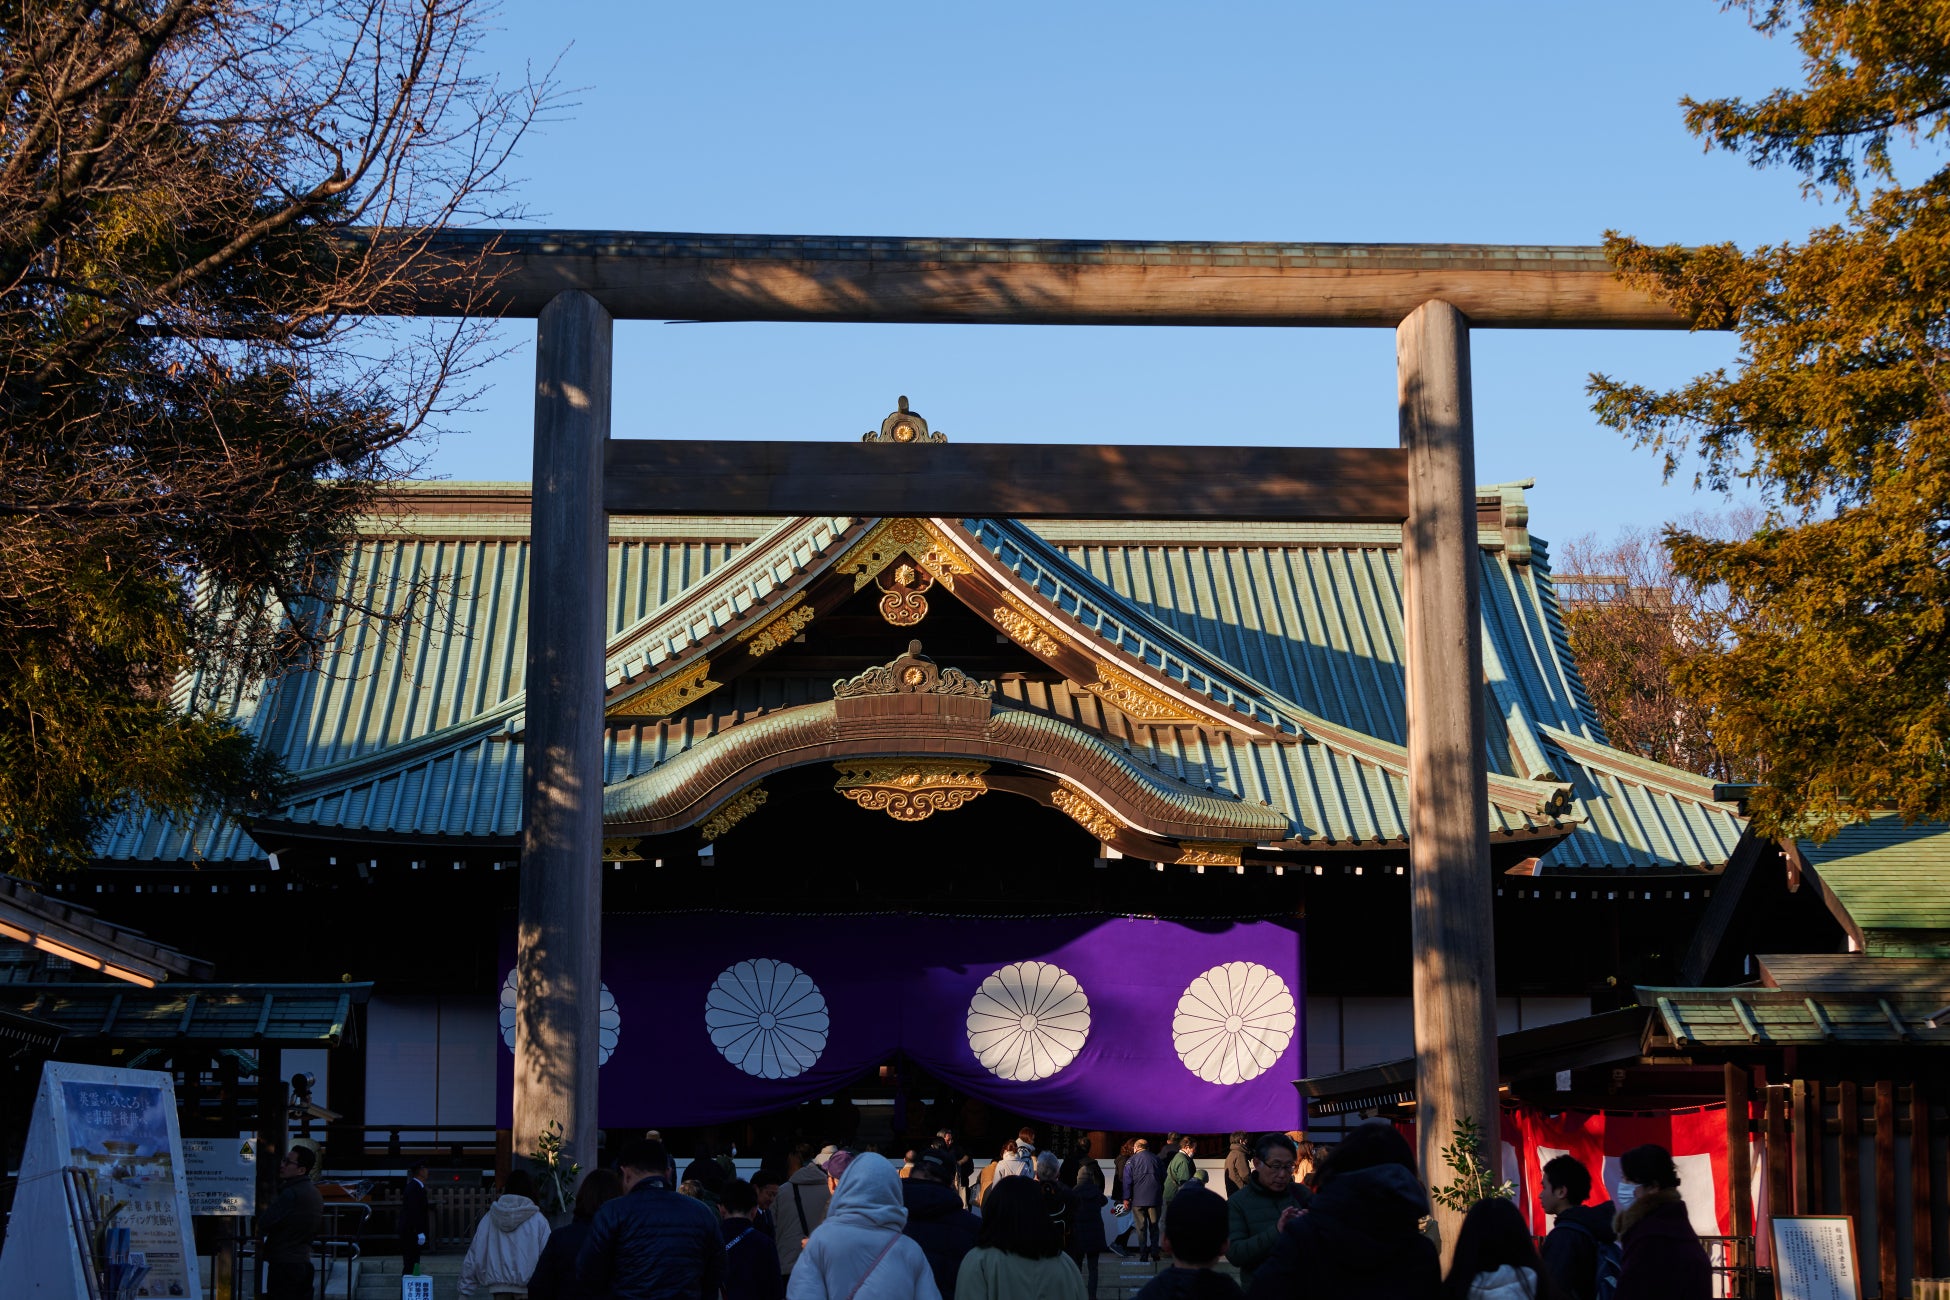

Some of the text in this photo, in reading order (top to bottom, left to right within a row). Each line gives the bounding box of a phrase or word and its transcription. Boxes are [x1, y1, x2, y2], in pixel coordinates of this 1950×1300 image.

[116, 1214, 174, 1226] ァンディング実施中
